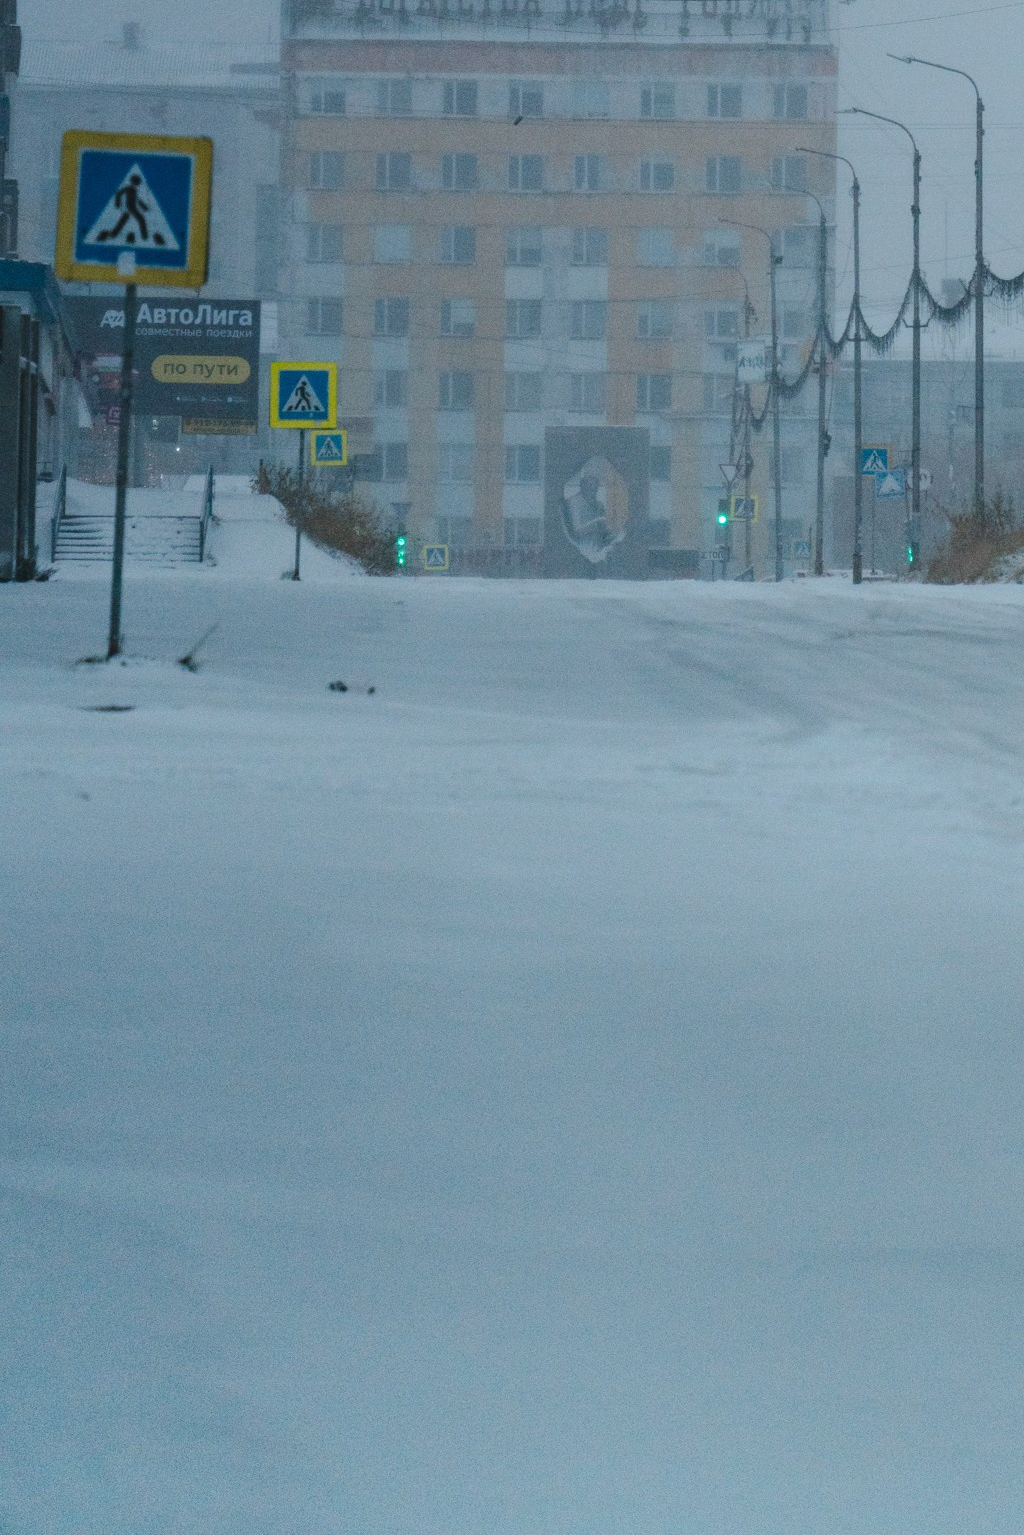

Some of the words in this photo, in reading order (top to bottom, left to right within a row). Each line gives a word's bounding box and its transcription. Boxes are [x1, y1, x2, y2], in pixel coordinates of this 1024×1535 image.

[136, 303, 253, 327] АвтоЛига
[135, 327, 203, 338] совместные
[206, 328, 253, 339] поездки
[163, 363, 188, 375] по
[193, 363, 240, 379] пути
